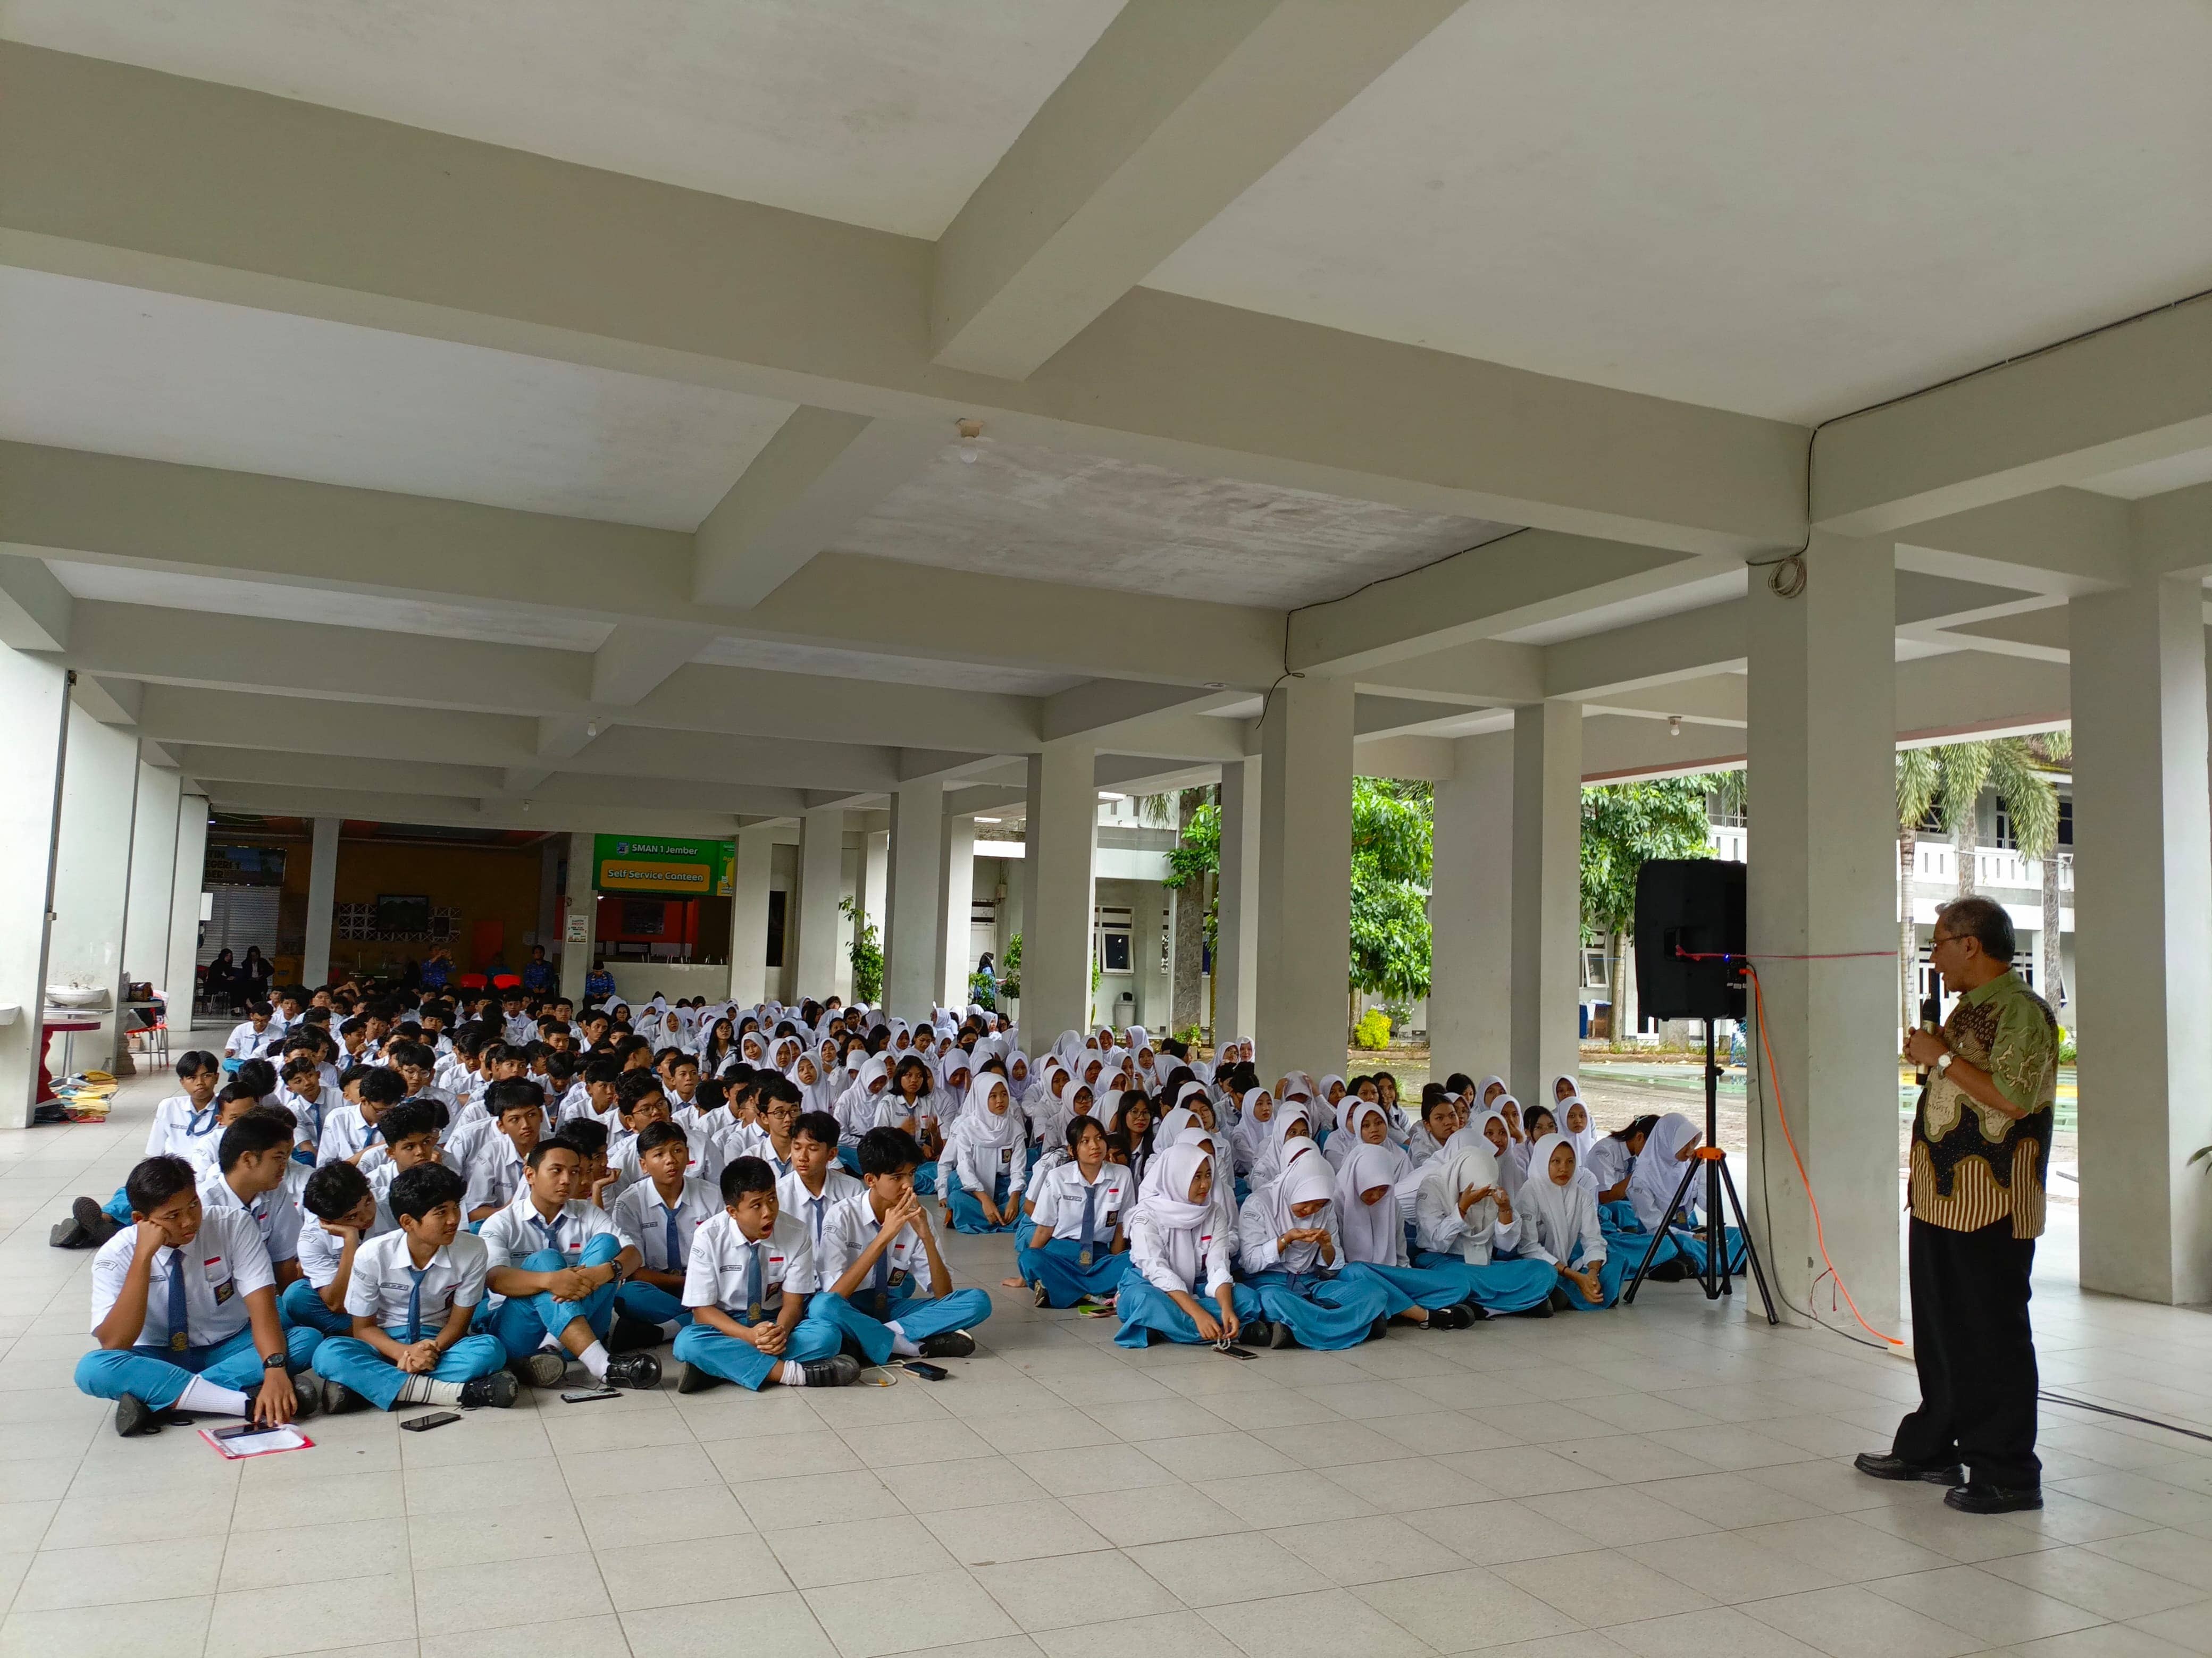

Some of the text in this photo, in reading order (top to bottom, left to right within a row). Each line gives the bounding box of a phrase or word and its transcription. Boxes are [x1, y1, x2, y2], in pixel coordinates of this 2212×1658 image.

[632, 844, 658, 853] SMAN
[665, 846, 698, 855] Jember
[608, 869, 703, 881] Self Service Canteen
